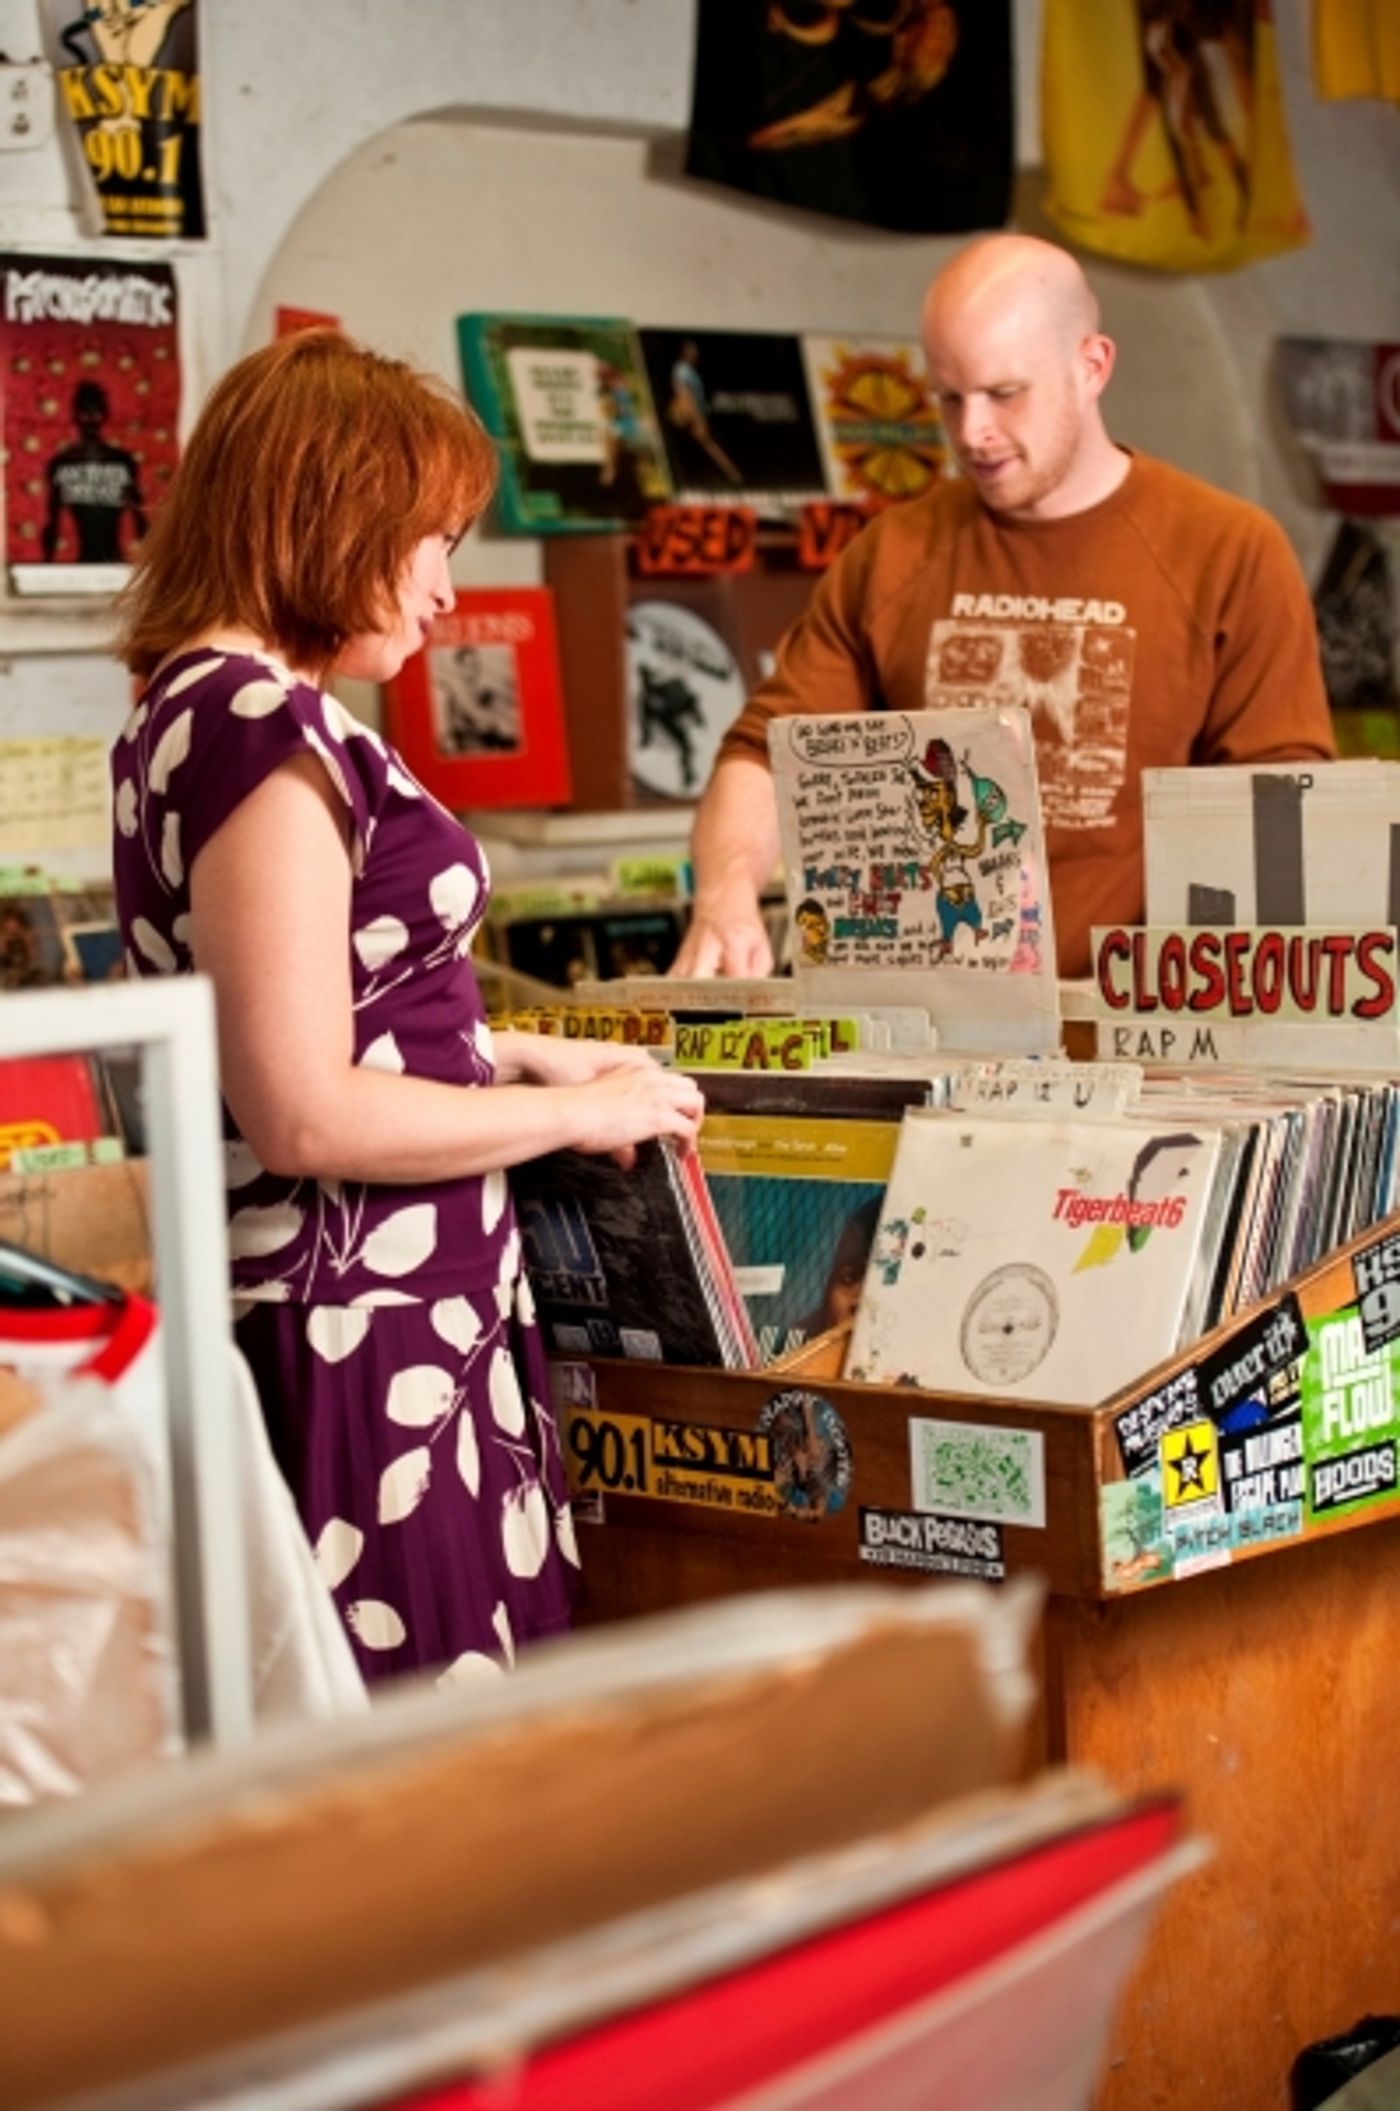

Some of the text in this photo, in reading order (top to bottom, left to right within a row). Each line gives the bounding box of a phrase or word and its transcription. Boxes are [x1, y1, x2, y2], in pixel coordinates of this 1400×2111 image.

[57, 63, 202, 124] KSYM
[85, 126, 182, 184] 90.1
[953, 593, 1127, 624] RADIOHEAD
[1097, 929, 1396, 1019] CLOSEOUTS
[675, 1026, 715, 1061] RAP
[1114, 1027, 1219, 1061] RAP M
[1052, 1188, 1187, 1229] Tigerbeat6
[1322, 1362, 1392, 1443] FLOW
[569, 1417, 770, 1492] 90.1 KSYM
[1180, 1456, 1199, 1483] R
[1315, 1447, 1395, 1506] HOODS
